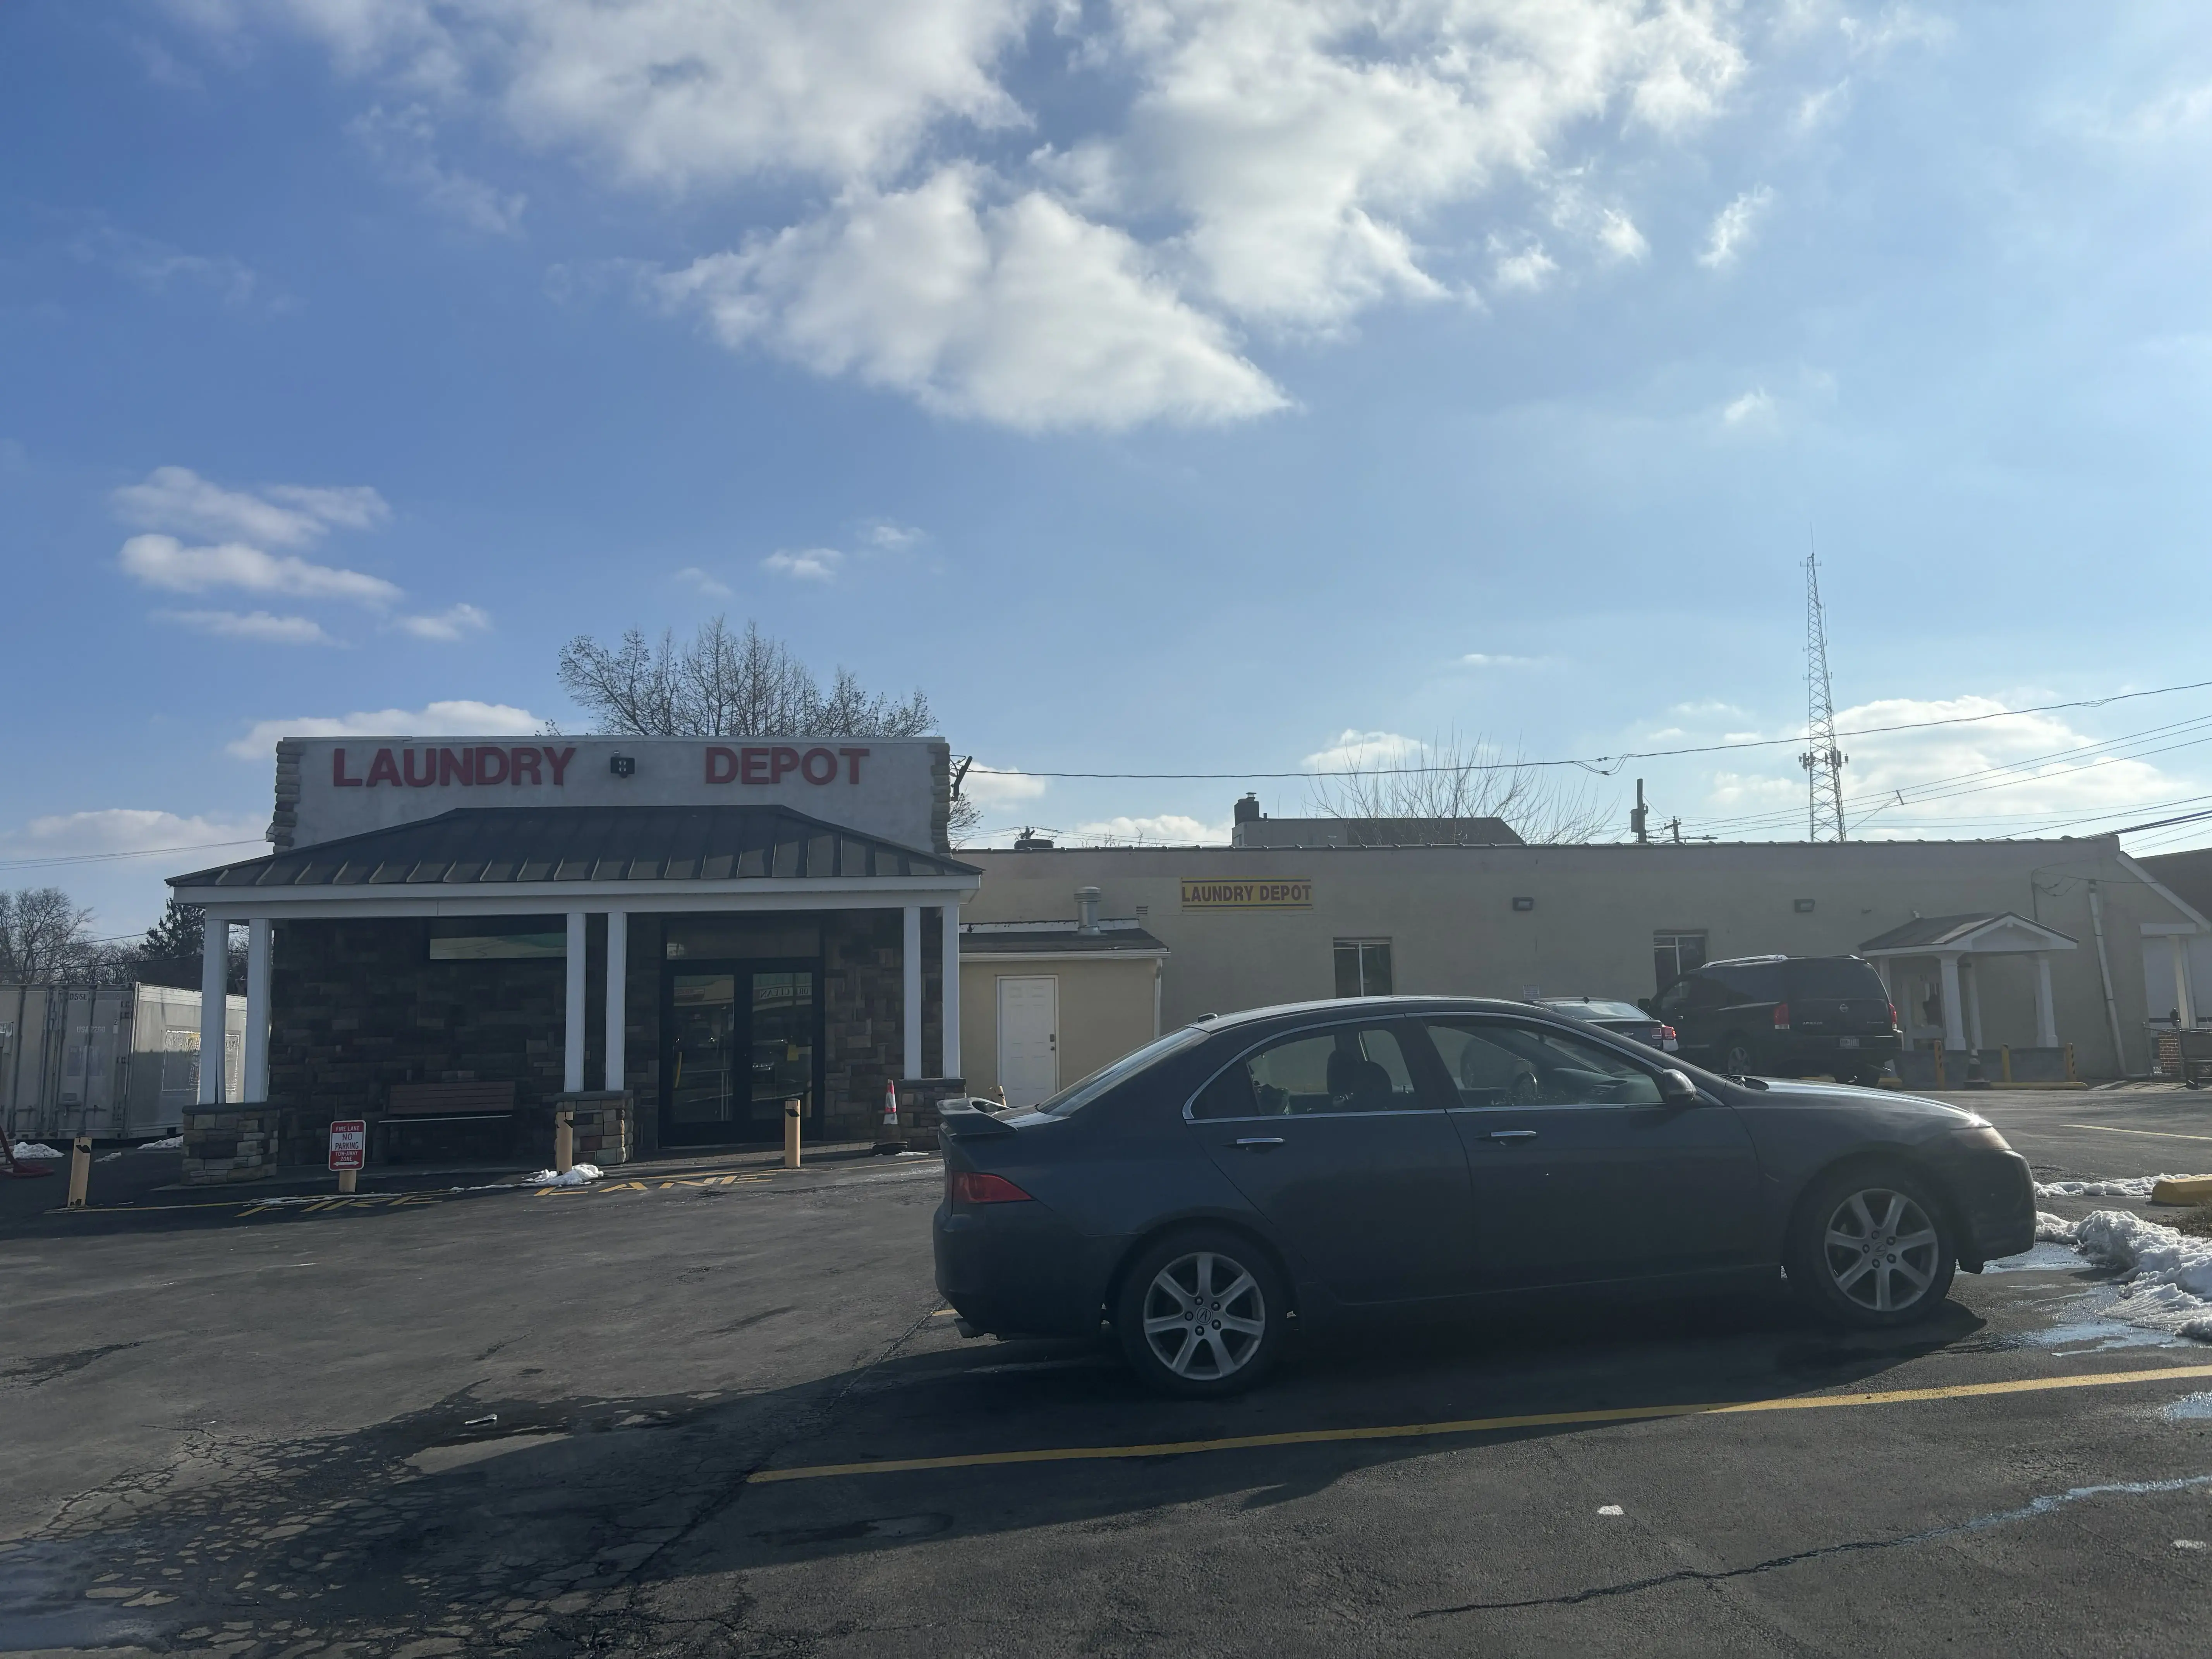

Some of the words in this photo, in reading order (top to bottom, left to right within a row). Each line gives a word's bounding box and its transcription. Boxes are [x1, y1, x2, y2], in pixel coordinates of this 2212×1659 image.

[333, 747, 576, 787] LAUNDRY
[706, 747, 870, 785] DEPOT
[1182, 885, 1254, 902] LAUNDRY
[1260, 885, 1312, 901] DEPOT
[335, 1142, 359, 1150] PARKING
[534, 1173, 776, 1196] LANE
